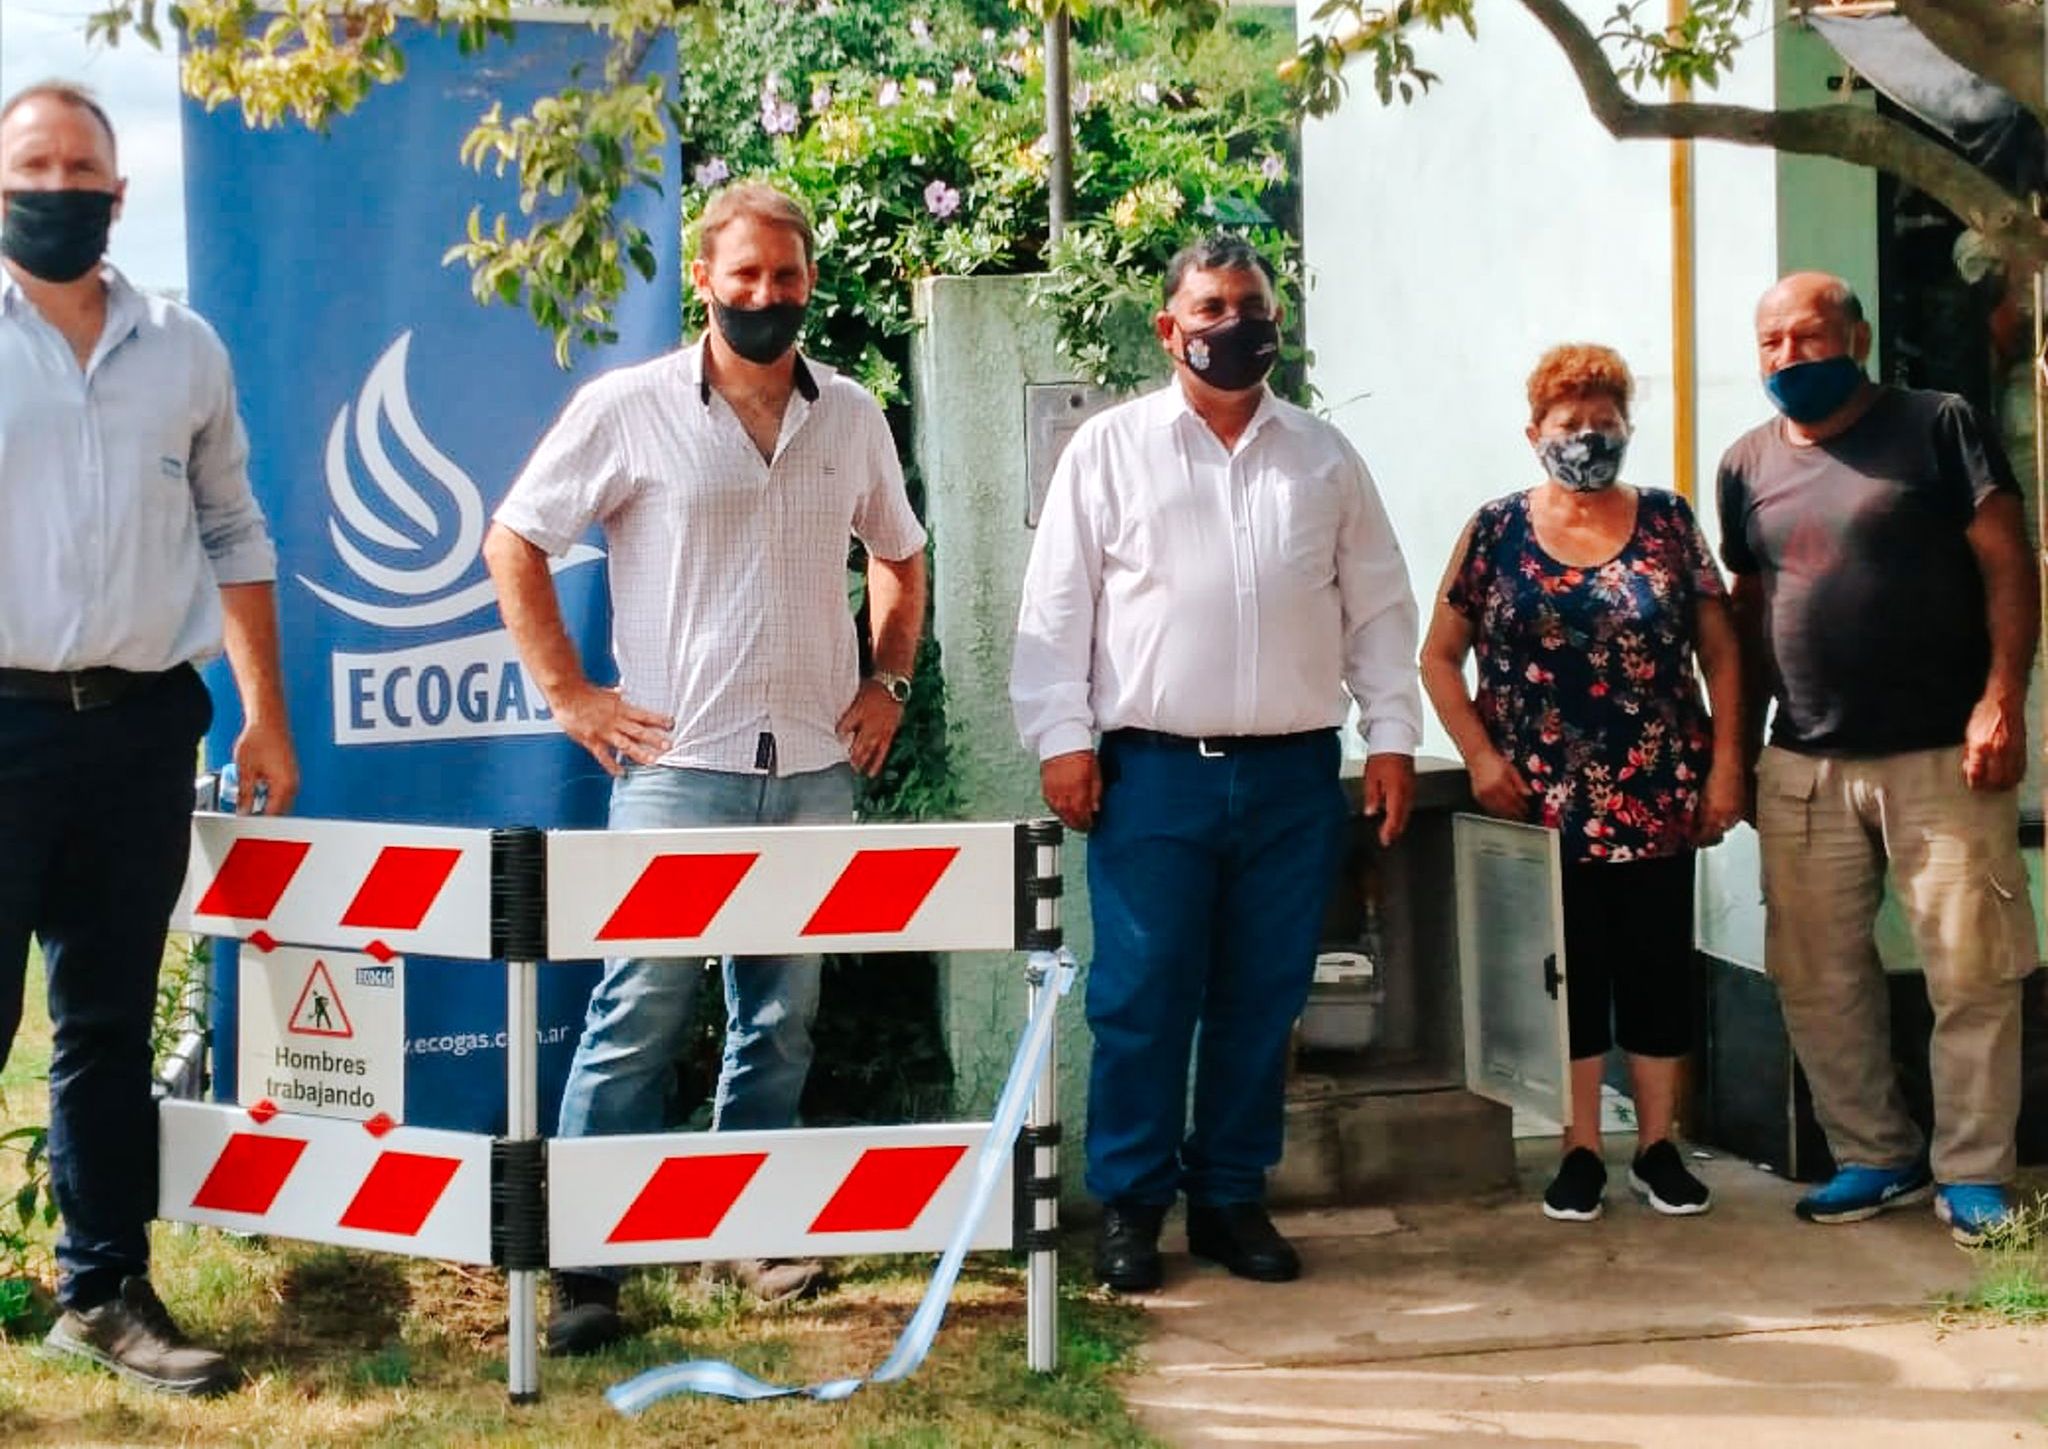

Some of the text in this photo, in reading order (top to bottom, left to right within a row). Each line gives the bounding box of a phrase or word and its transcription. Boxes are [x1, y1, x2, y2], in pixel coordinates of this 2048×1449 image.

[348, 661, 555, 730] ECOGA
[404, 1025, 569, 1056] .ecogas.c.ar
[275, 1046, 367, 1076] Hombres
[267, 1077, 375, 1109] trabajando
